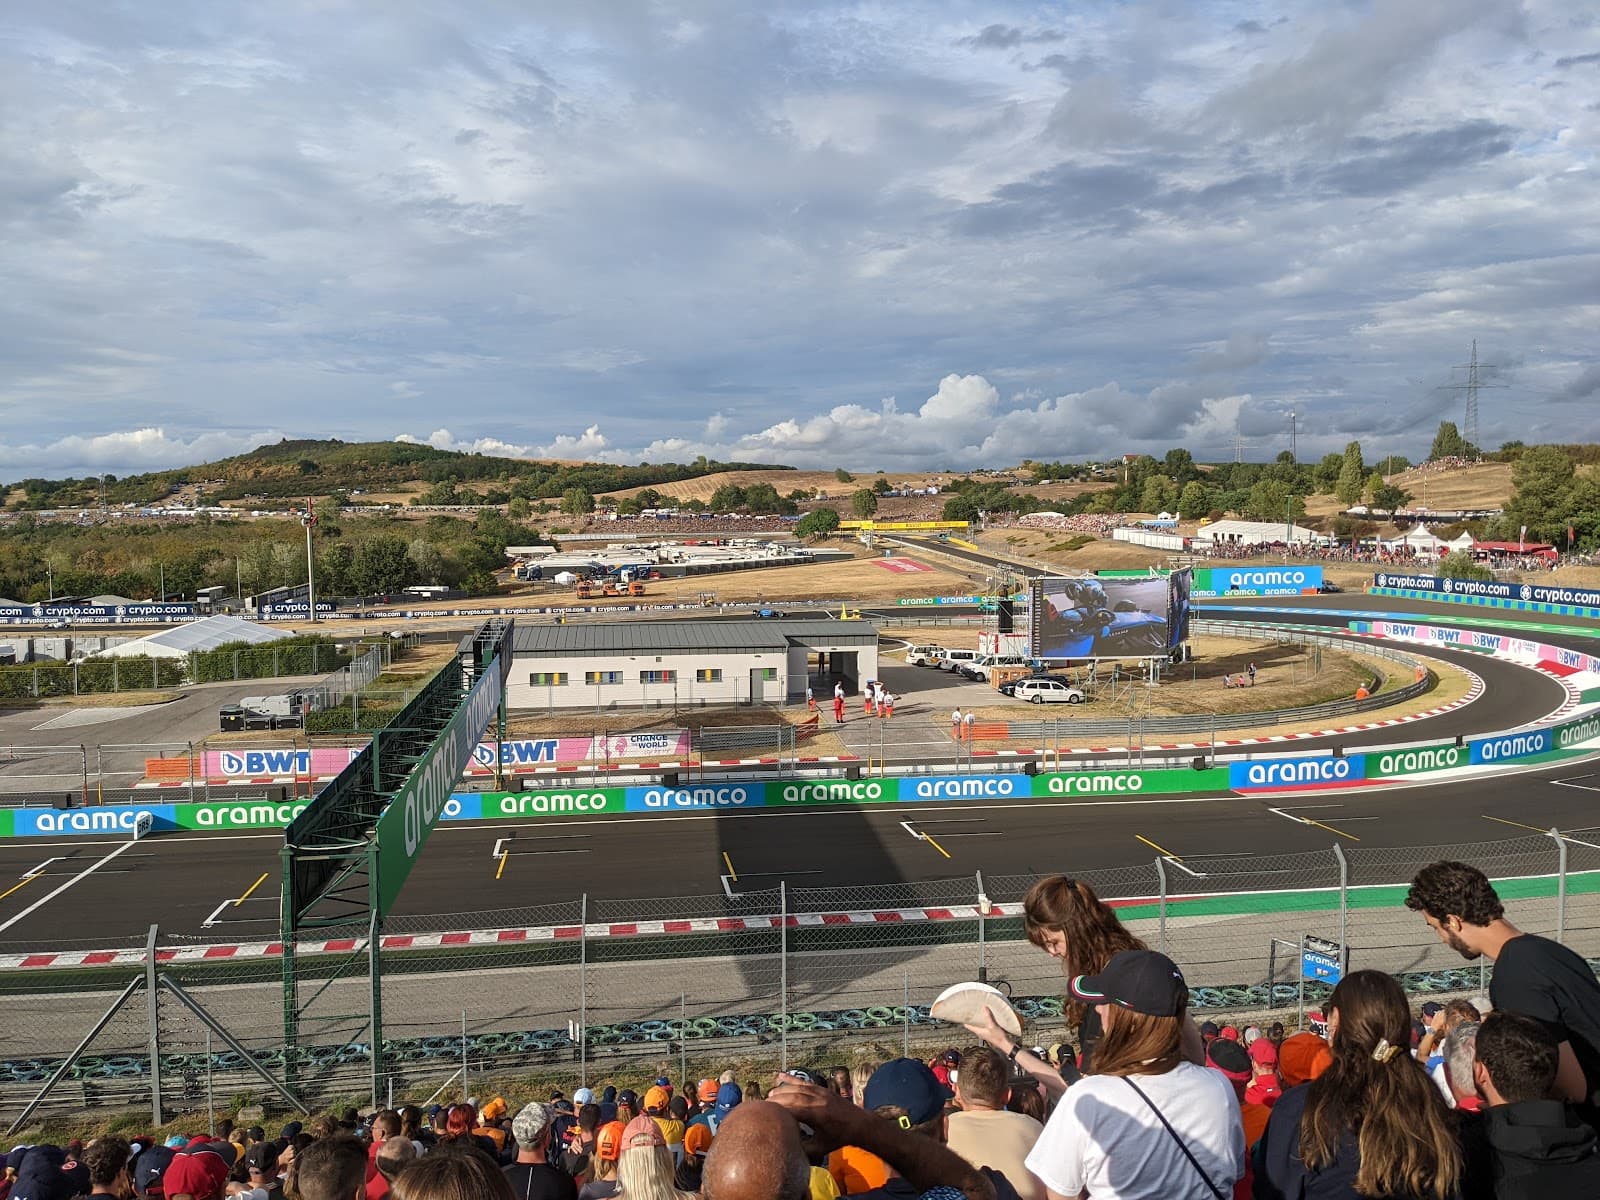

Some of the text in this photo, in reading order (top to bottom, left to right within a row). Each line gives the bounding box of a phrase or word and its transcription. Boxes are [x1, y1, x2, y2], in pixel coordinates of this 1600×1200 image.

[1230, 570, 1305, 586] aramco
[1387, 574, 1435, 589] crypto.com
[1190, 589, 1216, 597] ramco
[1224, 588, 1257, 596] aramco
[1264, 587, 1297, 595] aramco
[1454, 580, 1510, 597] crypto.com
[1533, 588, 1600, 605] crypto.com
[275, 601, 332, 613] crypto.om
[941, 596, 974, 604] aramco
[46, 606, 105, 617] crypto.com
[129, 605, 187, 616] crypto.com
[1392, 624, 1416, 637] BWT
[1437, 629, 1461, 643] BWT
[1480, 635, 1501, 649] BWT
[1563, 651, 1580, 668] BWT
[466, 671, 495, 747] aramco
[1560, 719, 1600, 745] aramco
[500, 741, 557, 764] BWT
[638, 741, 667, 749] WORLD
[1481, 734, 1544, 760] aramco
[246, 751, 310, 773] BWT
[1379, 747, 1458, 773] aramco
[1248, 759, 1349, 783] aramco
[783, 782, 882, 801] aramco
[916, 778, 1013, 797] aramco
[1048, 774, 1142, 793] aramco
[404, 729, 457, 857] aramco
[644, 787, 747, 808] aramco
[500, 792, 606, 814] aramco
